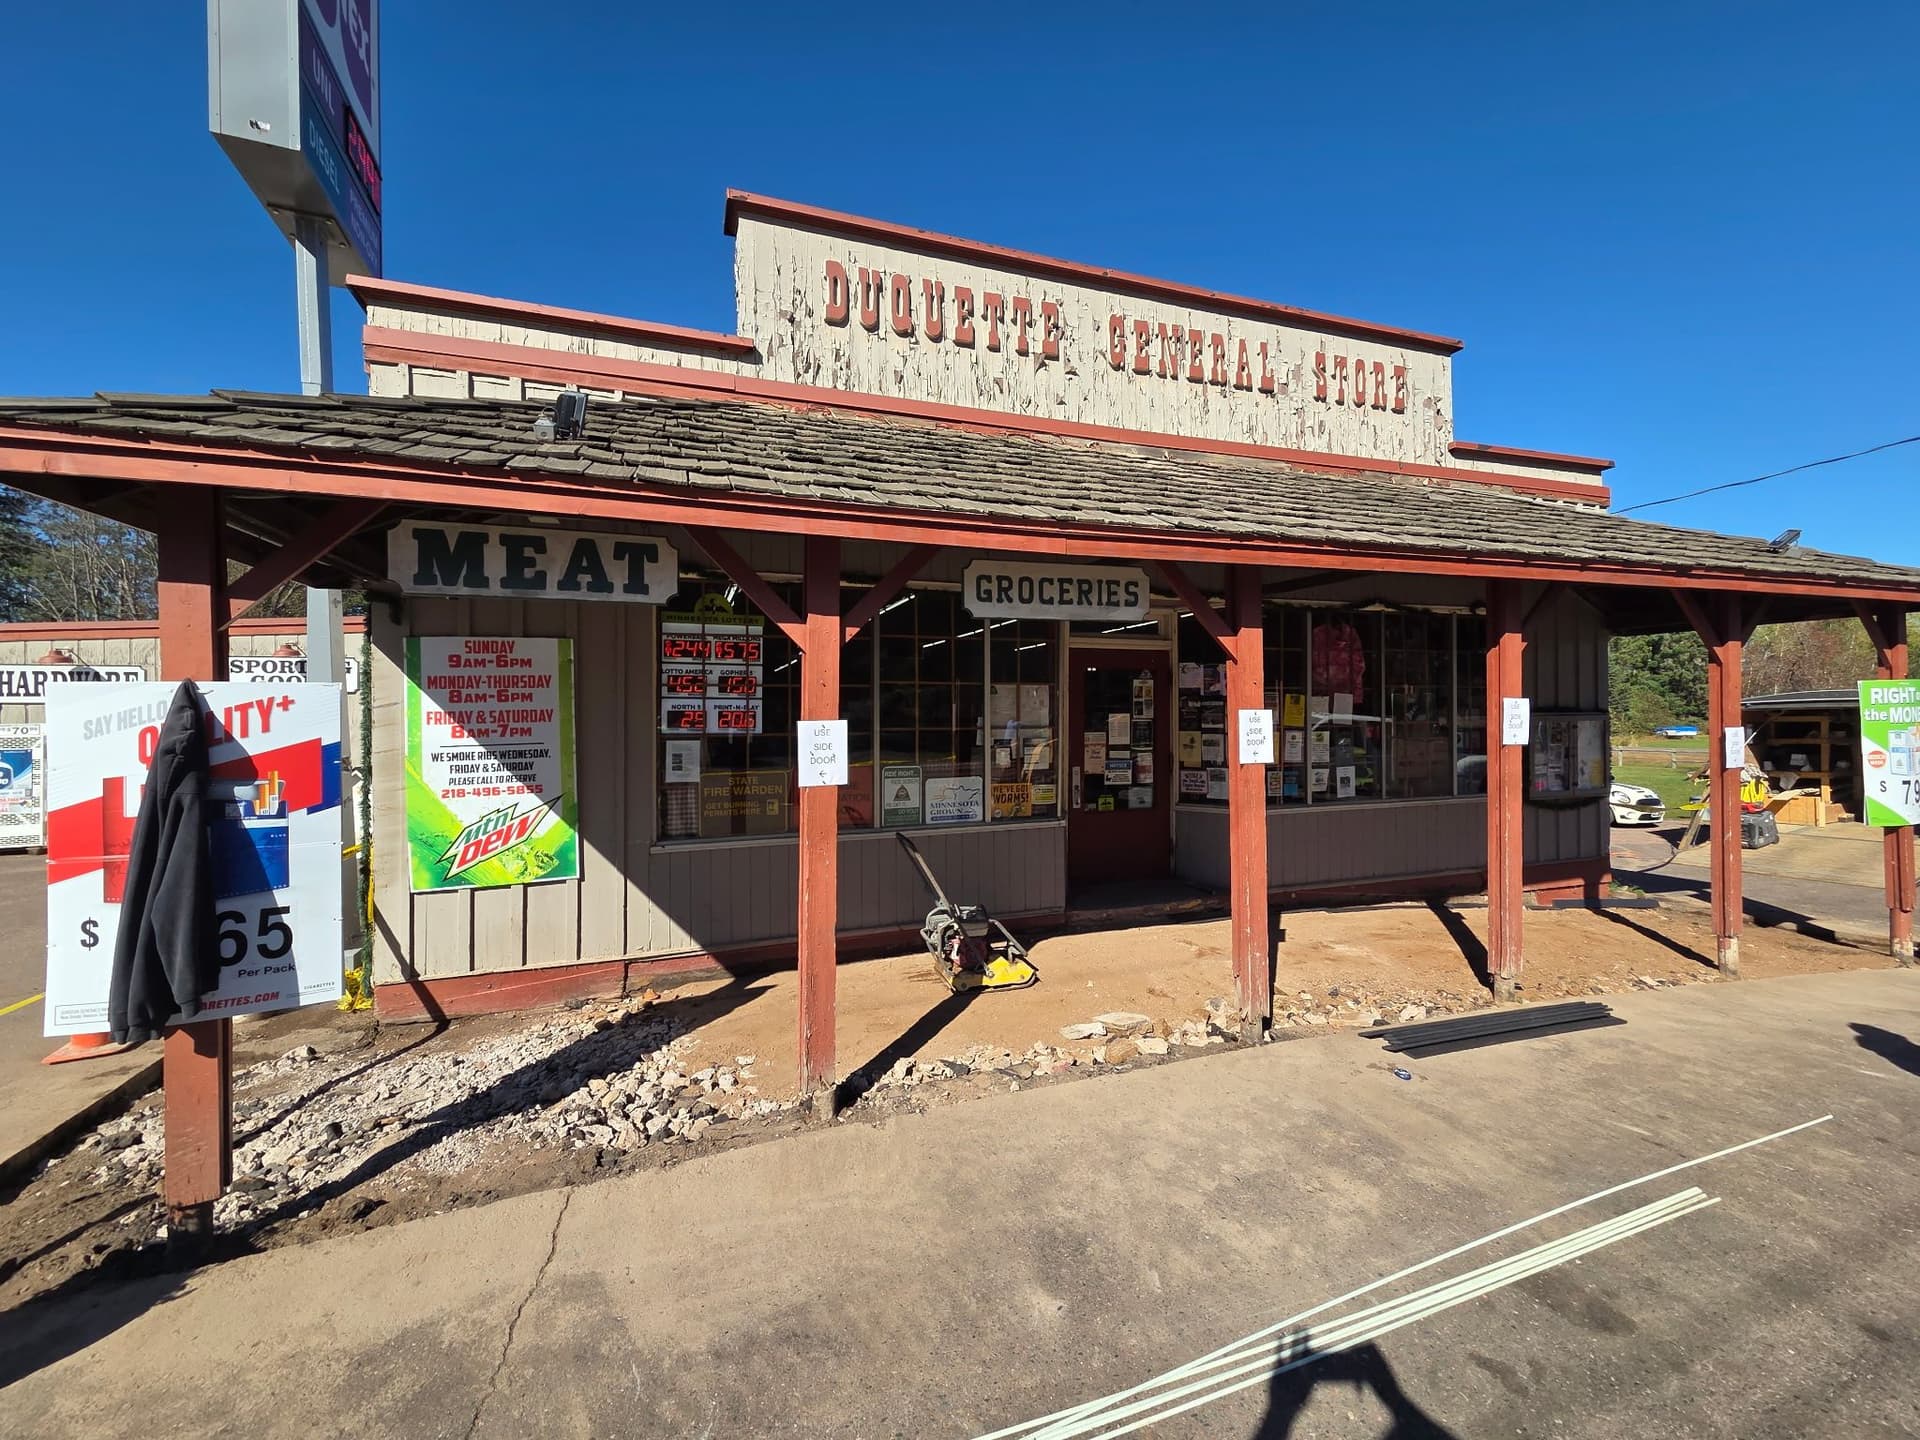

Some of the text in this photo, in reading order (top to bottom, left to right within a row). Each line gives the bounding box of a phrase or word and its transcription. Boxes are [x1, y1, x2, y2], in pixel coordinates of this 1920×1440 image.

[309, 118, 340, 195] DIESEL
[825, 259, 1408, 415] DUQUETTE GENERAL STORE
[411, 527, 659, 595] MEAT
[976, 574, 1141, 607] GROCERIES
[464, 640, 516, 654] SUNDAY
[230, 659, 352, 674] SPORT
[448, 654, 532, 669] 9AM-6PM
[427, 674, 552, 690] MONDAY-THURSDAY
[448, 689, 533, 704] 8AM-6PM
[1870, 687, 1916, 705] RIGHT
[83, 699, 167, 741] SAY HELLO
[426, 708, 554, 726] FRIDAY & SATURDAY
[1864, 708, 1889, 721] the
[138, 695, 296, 769] QLITY+
[451, 723, 532, 740] 8AM-7PM
[813, 728, 831, 737] USE
[813, 743, 833, 751] SIDE
[431, 752, 445, 763] WE
[446, 751, 477, 761] SMOKE
[477, 750, 499, 761] RIBS
[809, 757, 837, 765] DOOR
[449, 761, 535, 775] FRIDAY & SATURDAY
[448, 773, 537, 787] PLEASE CALL TO RESERVE
[728, 776, 759, 785] STATE
[441, 784, 544, 799] 218-496-5855
[703, 785, 783, 797] FIRE WARDEN
[992, 792, 1030, 804] WORMS!
[929, 800, 980, 809] MINNESOTA
[929, 807, 963, 816] GROWN
[456, 812, 510, 850] Mtn
[80, 916, 100, 951] $
[237, 963, 297, 979] Per Pack
